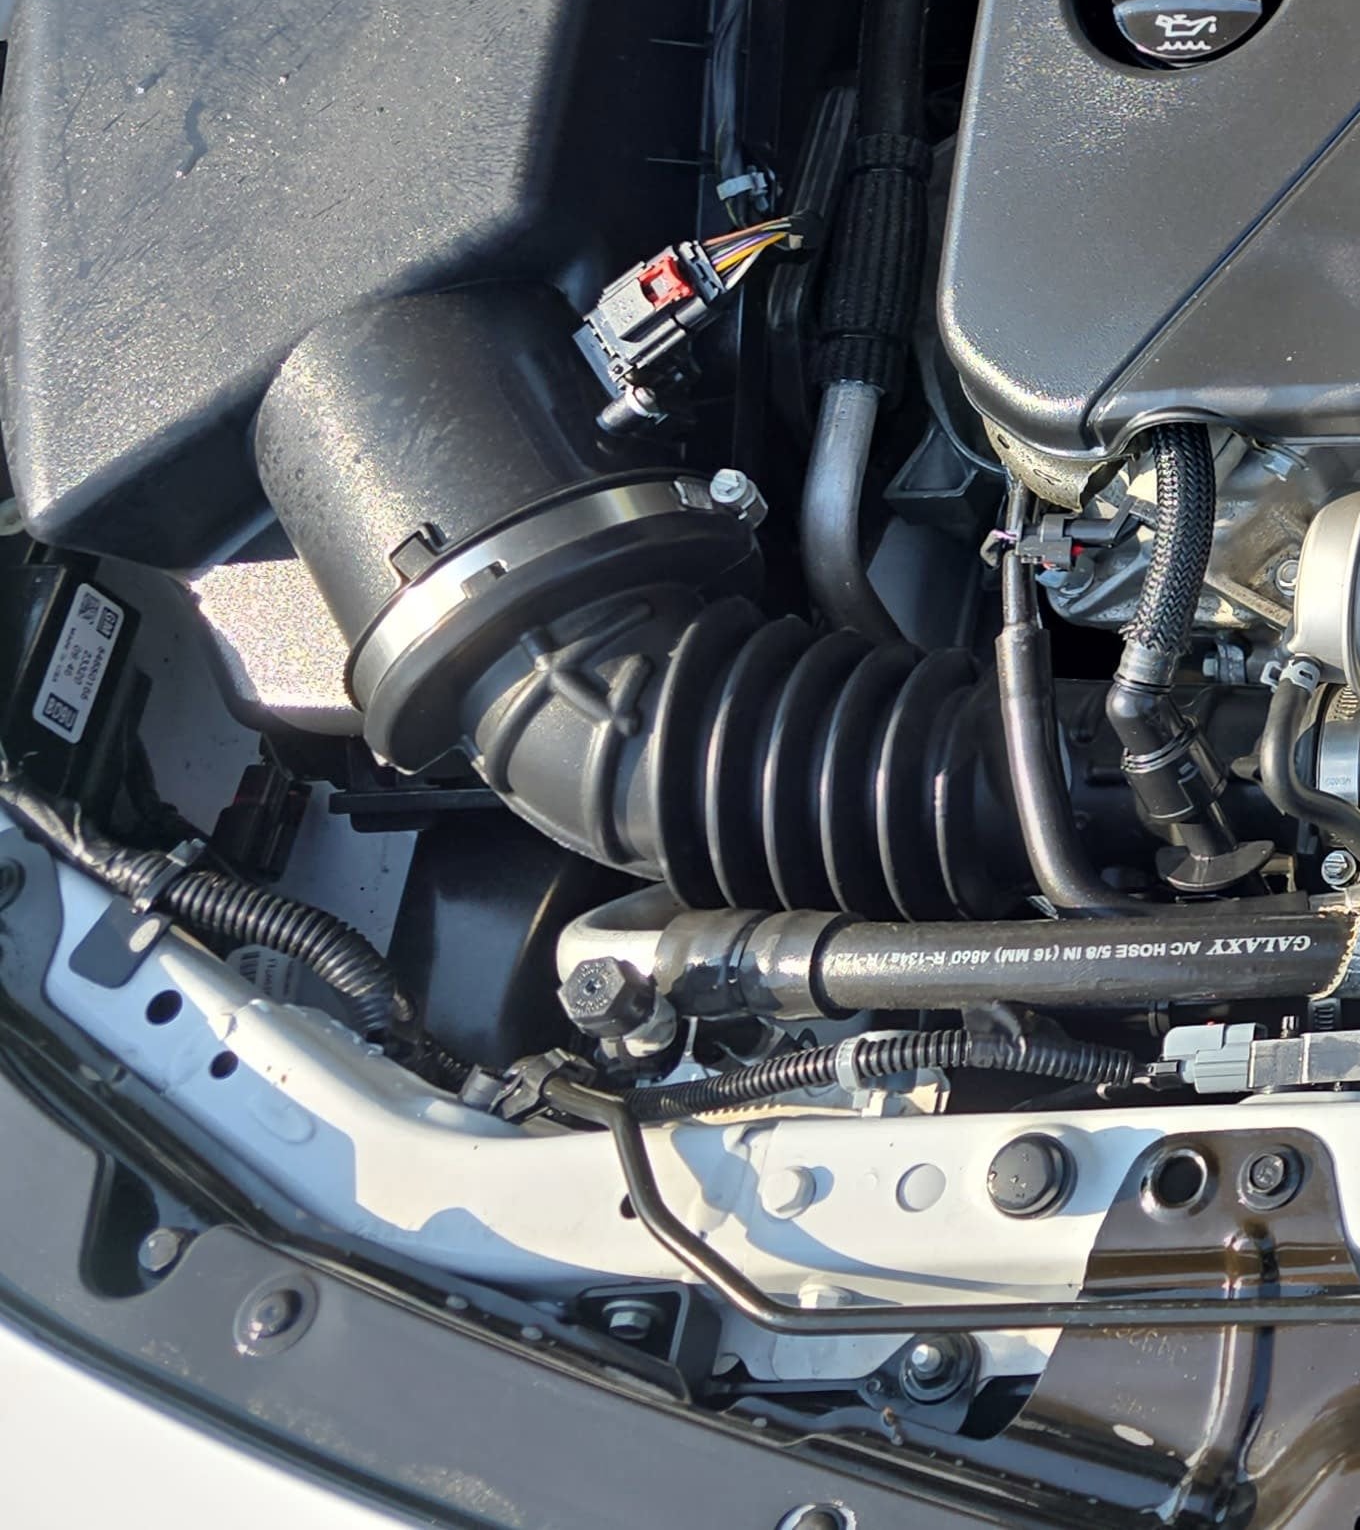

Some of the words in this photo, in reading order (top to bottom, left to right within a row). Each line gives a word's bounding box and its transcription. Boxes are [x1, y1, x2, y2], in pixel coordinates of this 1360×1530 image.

[99, 609, 117, 636] GM
[1063, 945, 1082, 961] IN
[1085, 944, 1112, 961] 5/8
[1115, 942, 1166, 959] HOSE
[1170, 939, 1201, 957] A/C
[1207, 934, 1311, 955] GALAXY
[993, 945, 1030, 964] MM)
